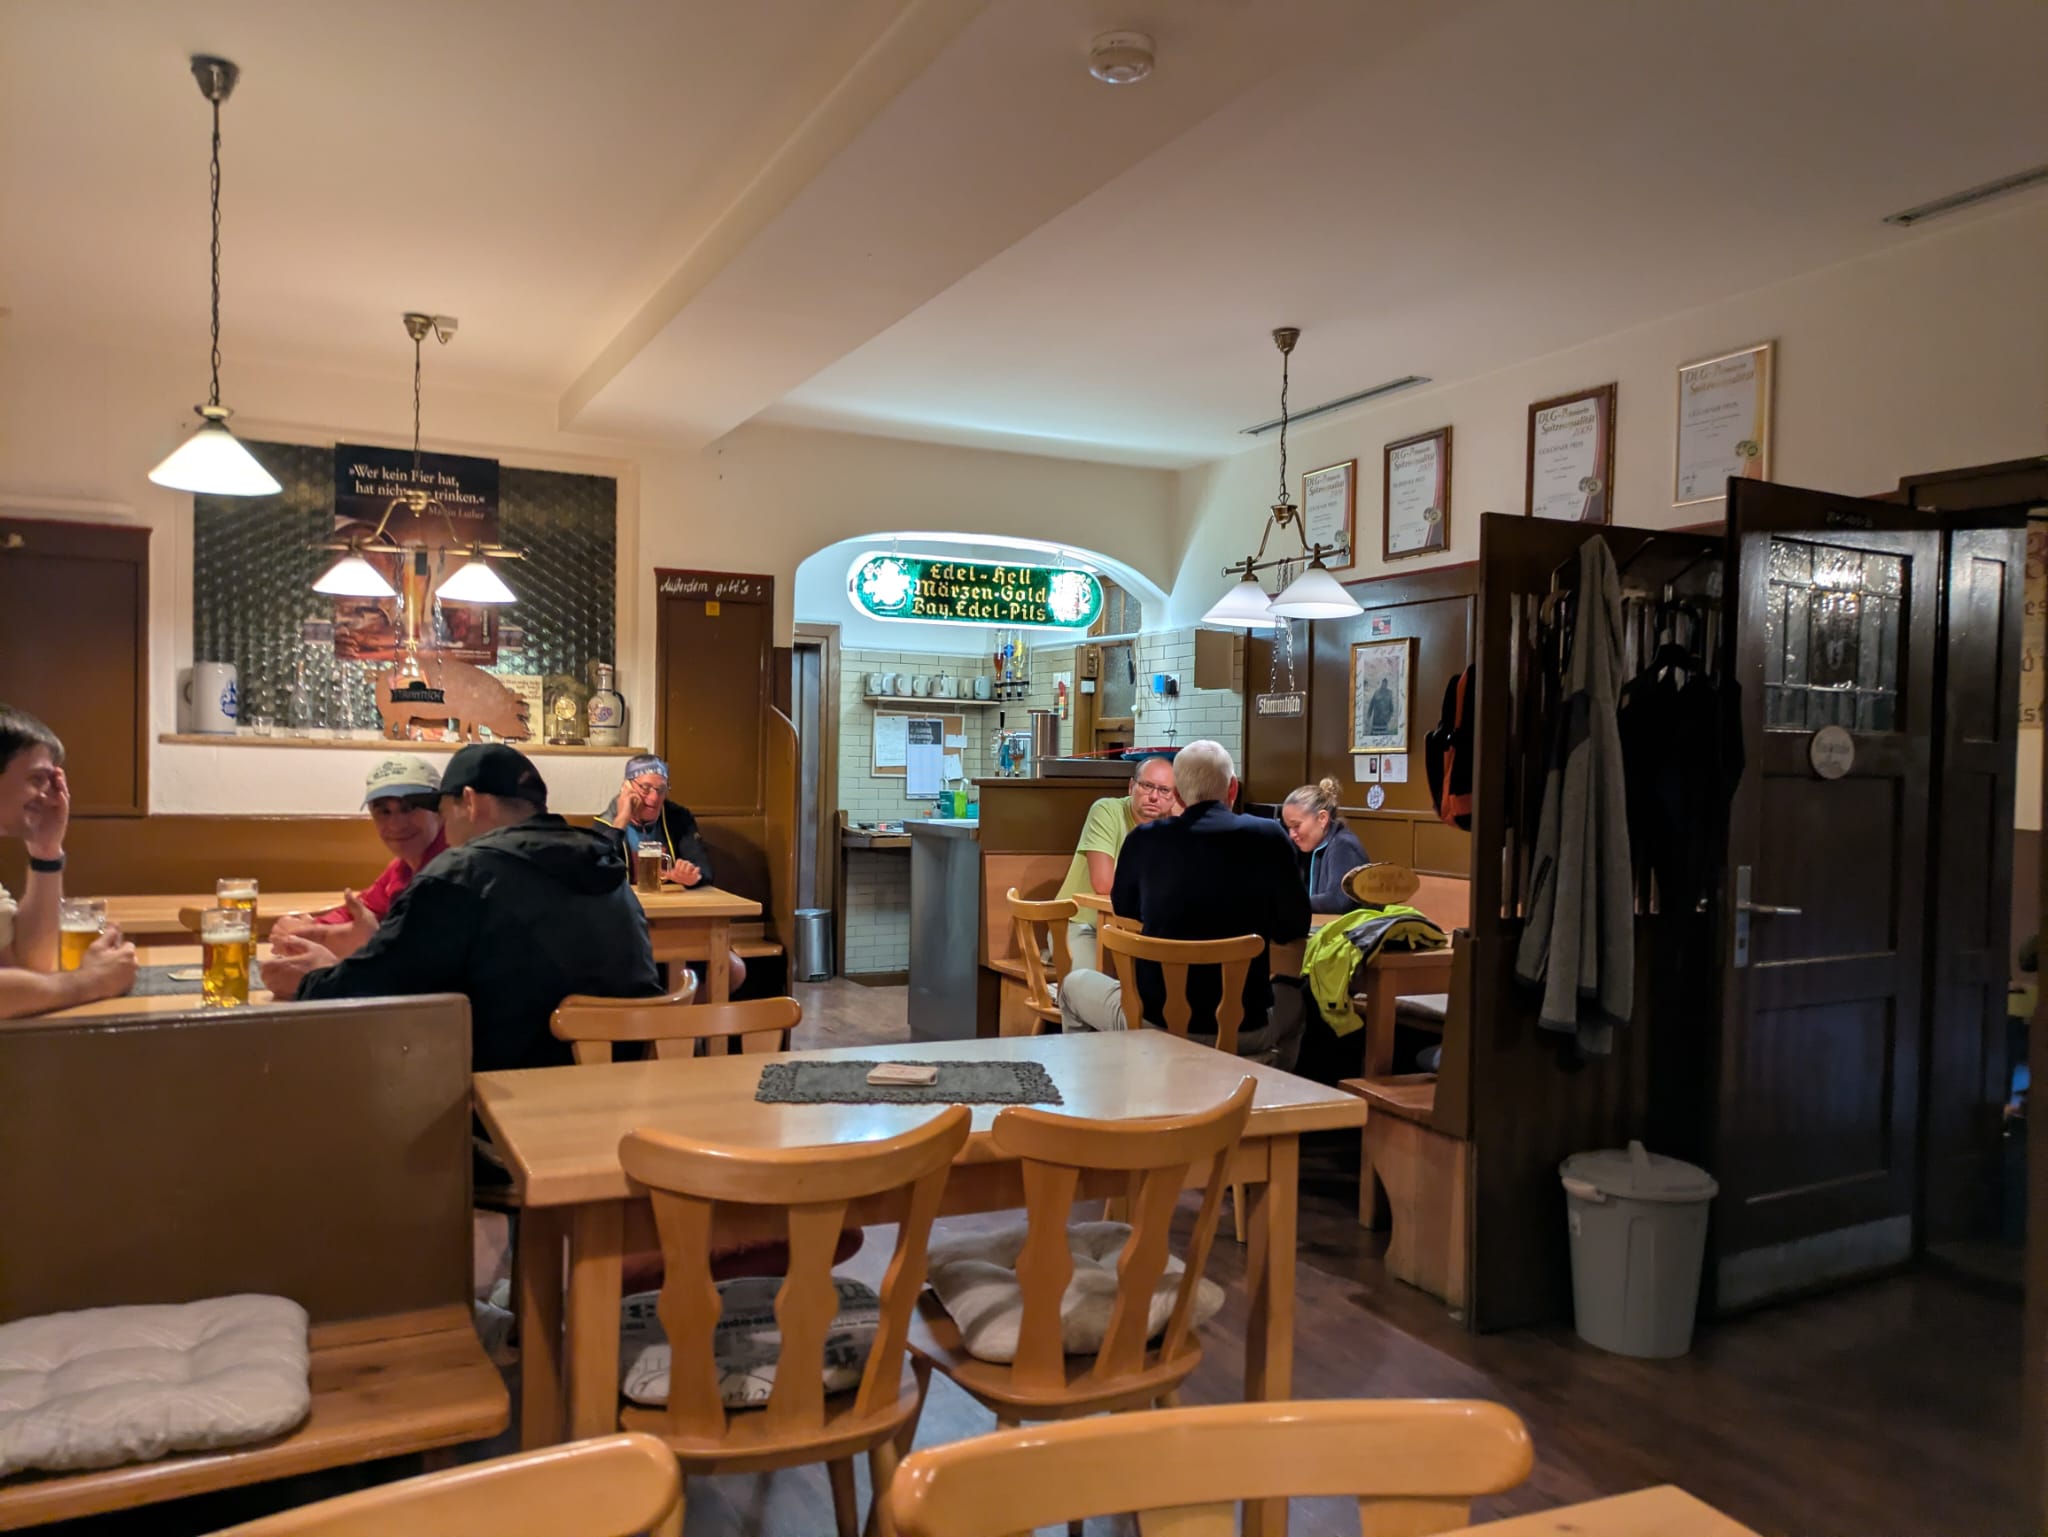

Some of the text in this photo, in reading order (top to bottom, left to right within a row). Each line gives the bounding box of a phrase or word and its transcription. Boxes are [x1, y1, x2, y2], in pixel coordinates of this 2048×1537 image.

[348, 463, 379, 479] »Wer
[382, 466, 408, 482] kein
[438, 471, 460, 488] hat,
[355, 479, 374, 495] hat
[434, 488, 486, 505] trinken.«
[911, 597, 1046, 621] Bay. Edel-Pils
